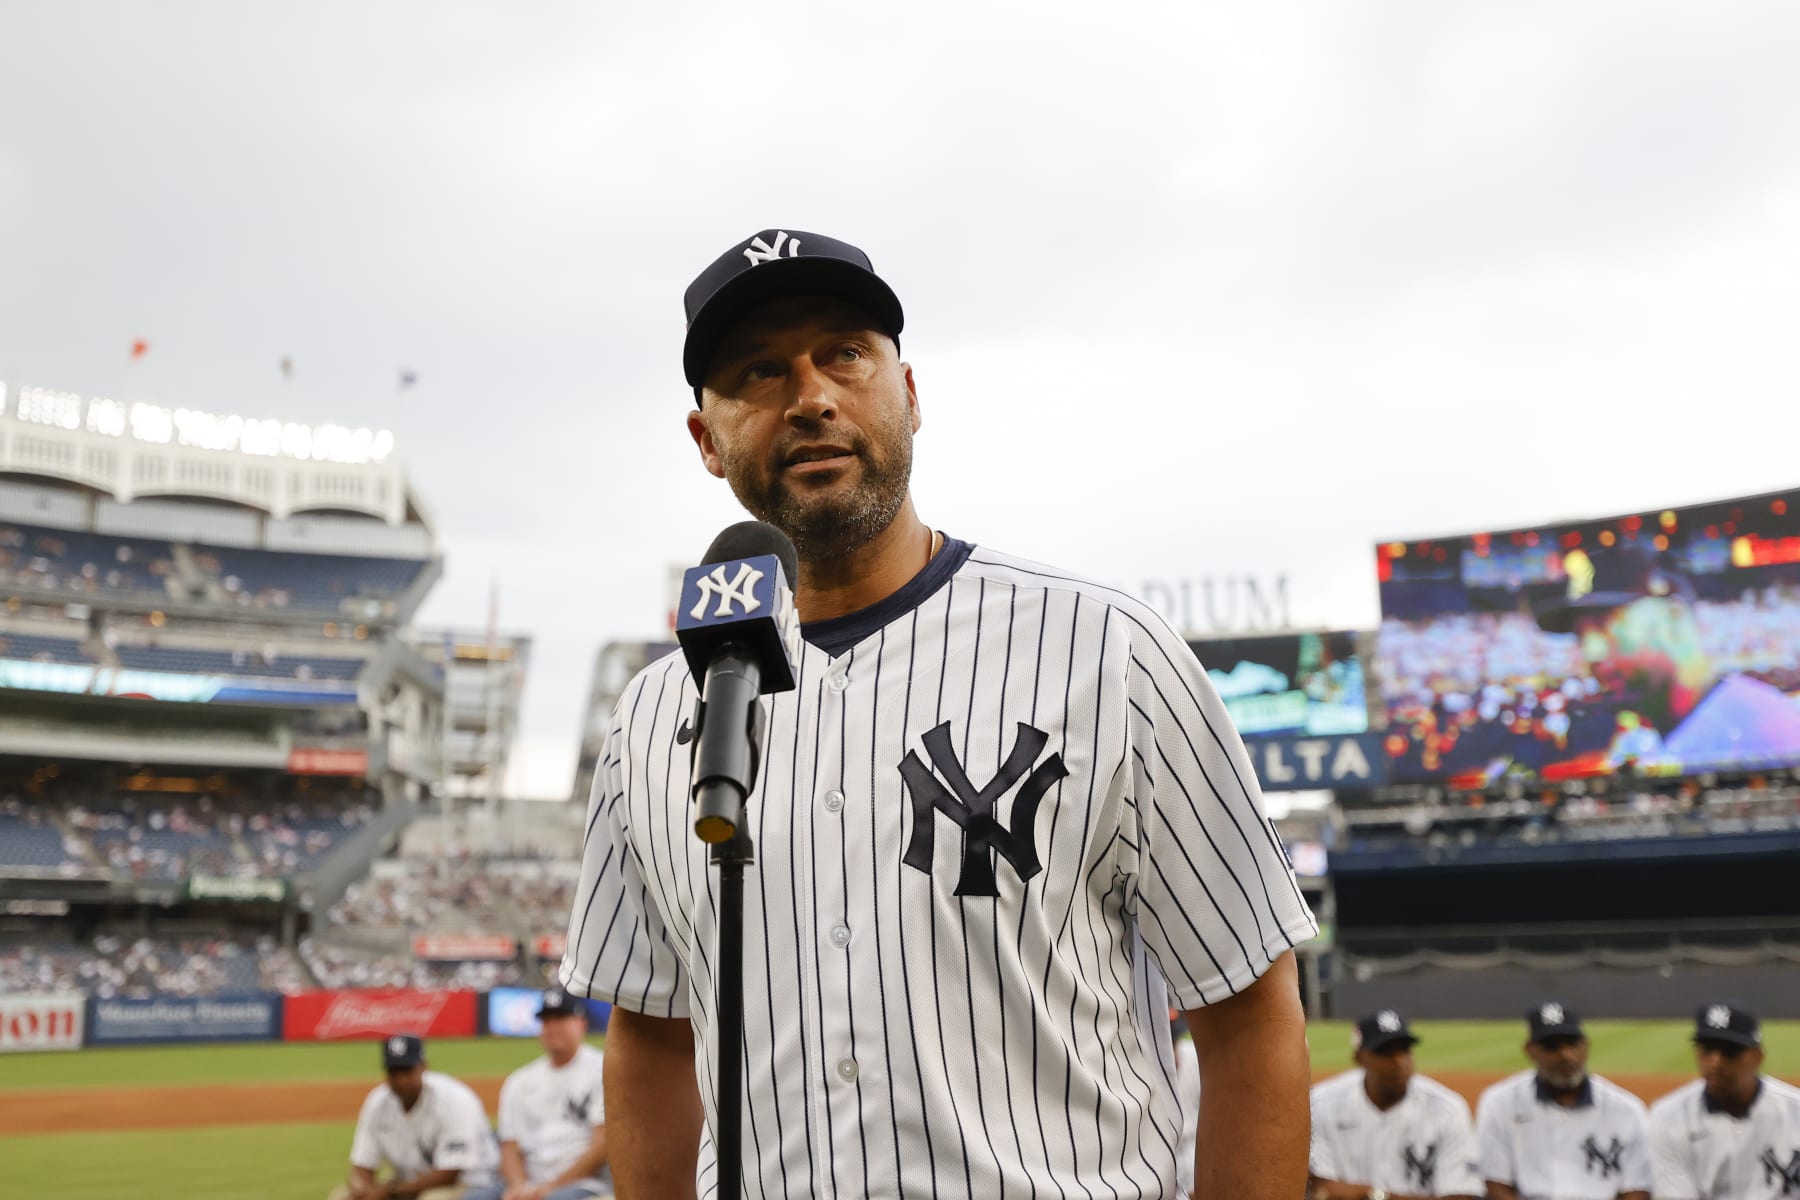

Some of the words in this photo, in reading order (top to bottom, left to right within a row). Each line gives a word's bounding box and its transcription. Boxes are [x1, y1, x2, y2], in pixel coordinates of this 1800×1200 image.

[742, 230, 801, 267] NY
[689, 562, 764, 620] NY
[1246, 738, 1371, 784] LTA
[897, 720, 1070, 897] NY
[0, 1011, 73, 1039] on
[1583, 1135, 1624, 1178] NY
